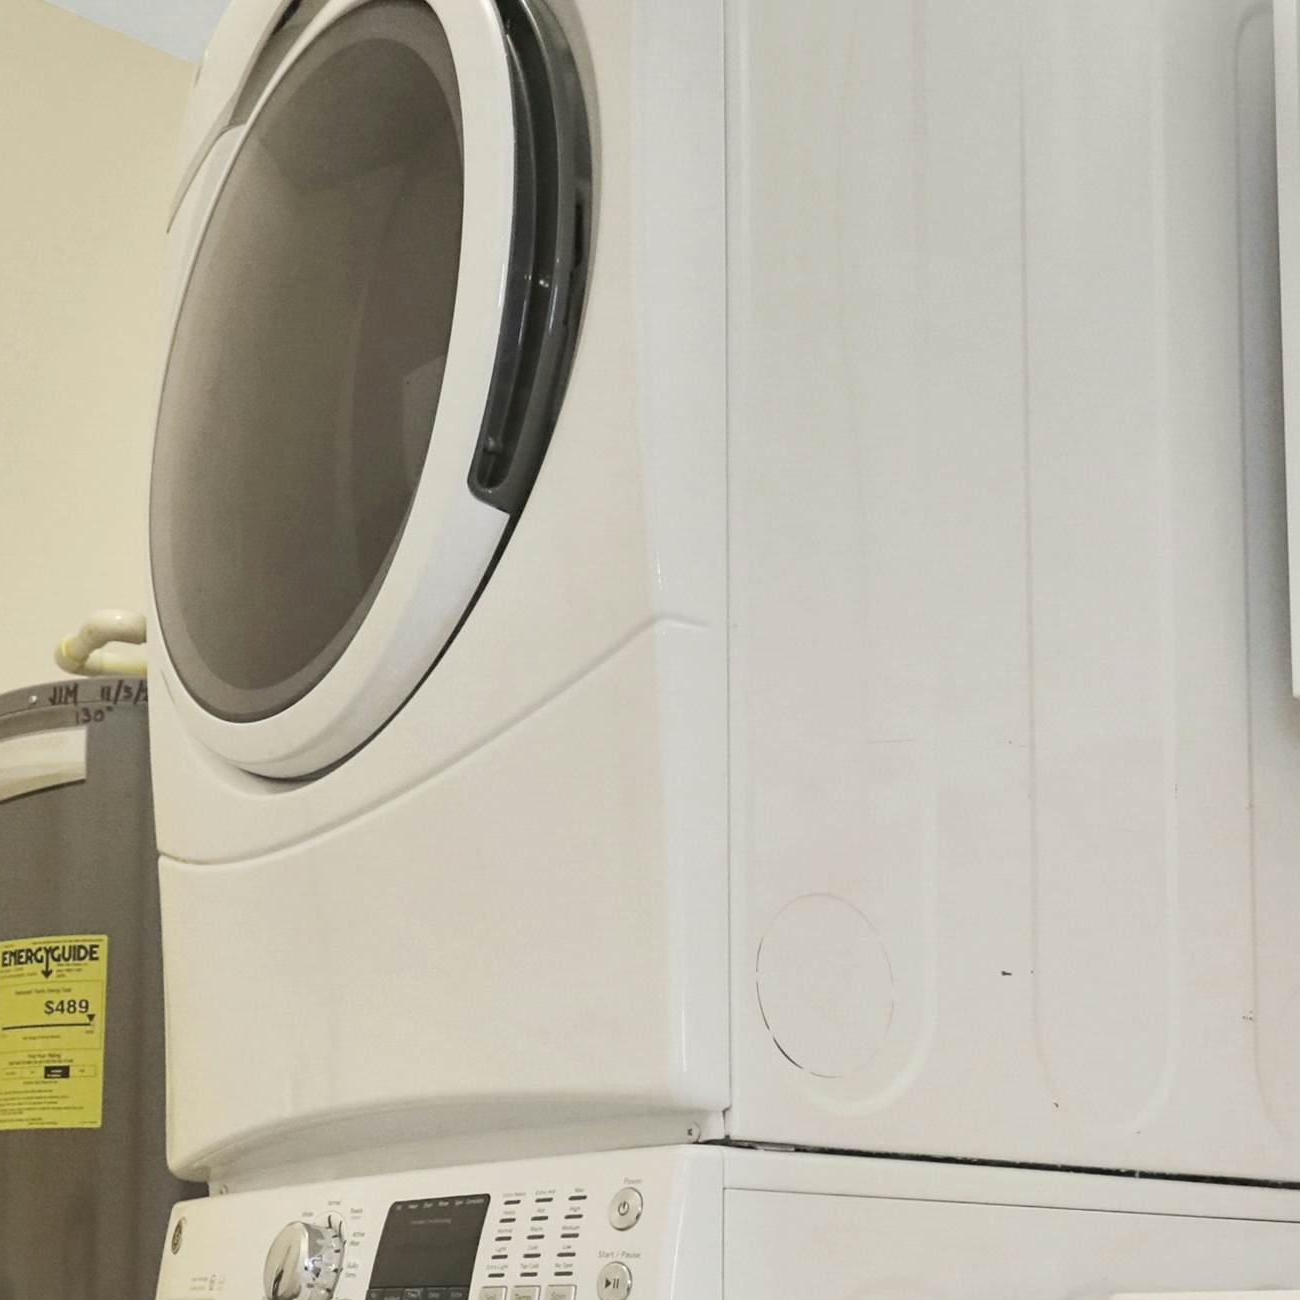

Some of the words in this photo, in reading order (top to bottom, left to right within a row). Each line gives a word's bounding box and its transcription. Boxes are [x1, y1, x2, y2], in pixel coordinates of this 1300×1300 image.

[48, 683, 79, 706] JIM
[1, 944, 100, 968] ENERGYGUIDE
[43, 998, 90, 1016] $489
